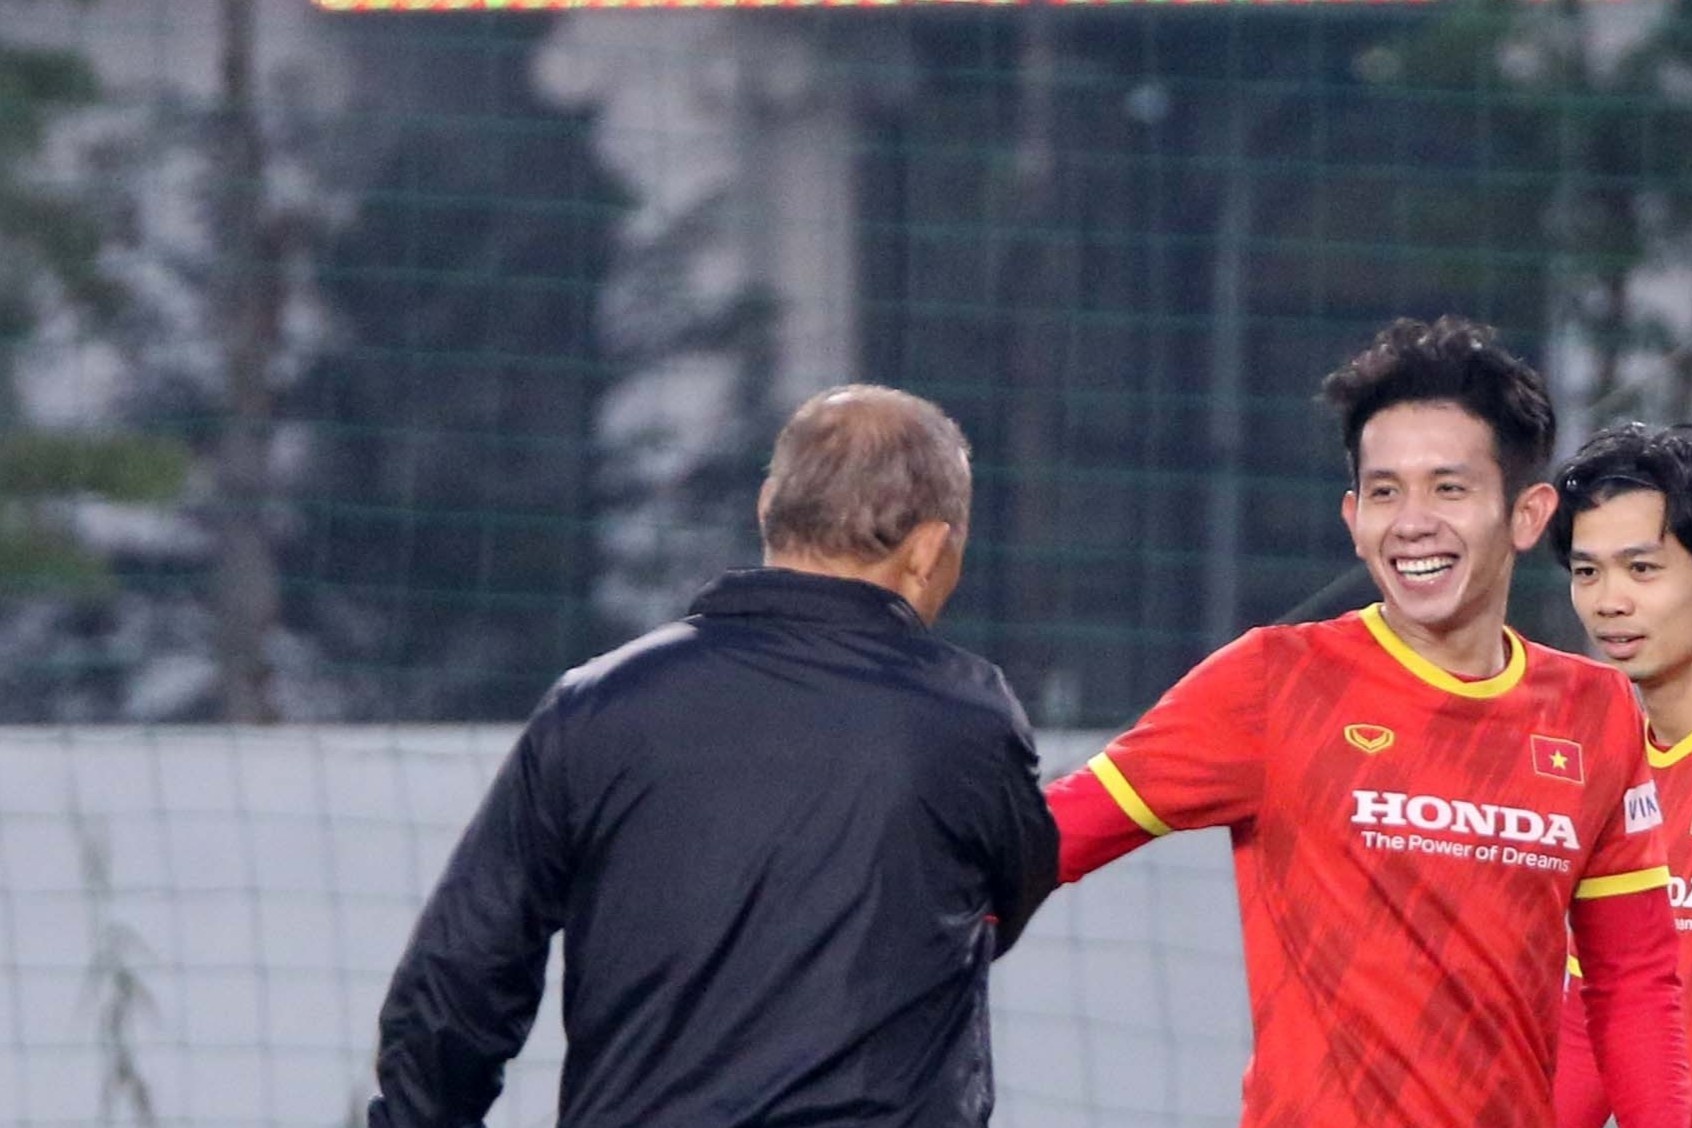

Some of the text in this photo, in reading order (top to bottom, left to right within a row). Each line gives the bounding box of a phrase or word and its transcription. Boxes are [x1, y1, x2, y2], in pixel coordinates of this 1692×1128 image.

[1351, 790, 1580, 849] HONDA
[1361, 831, 1571, 872] The Power of Dreams
